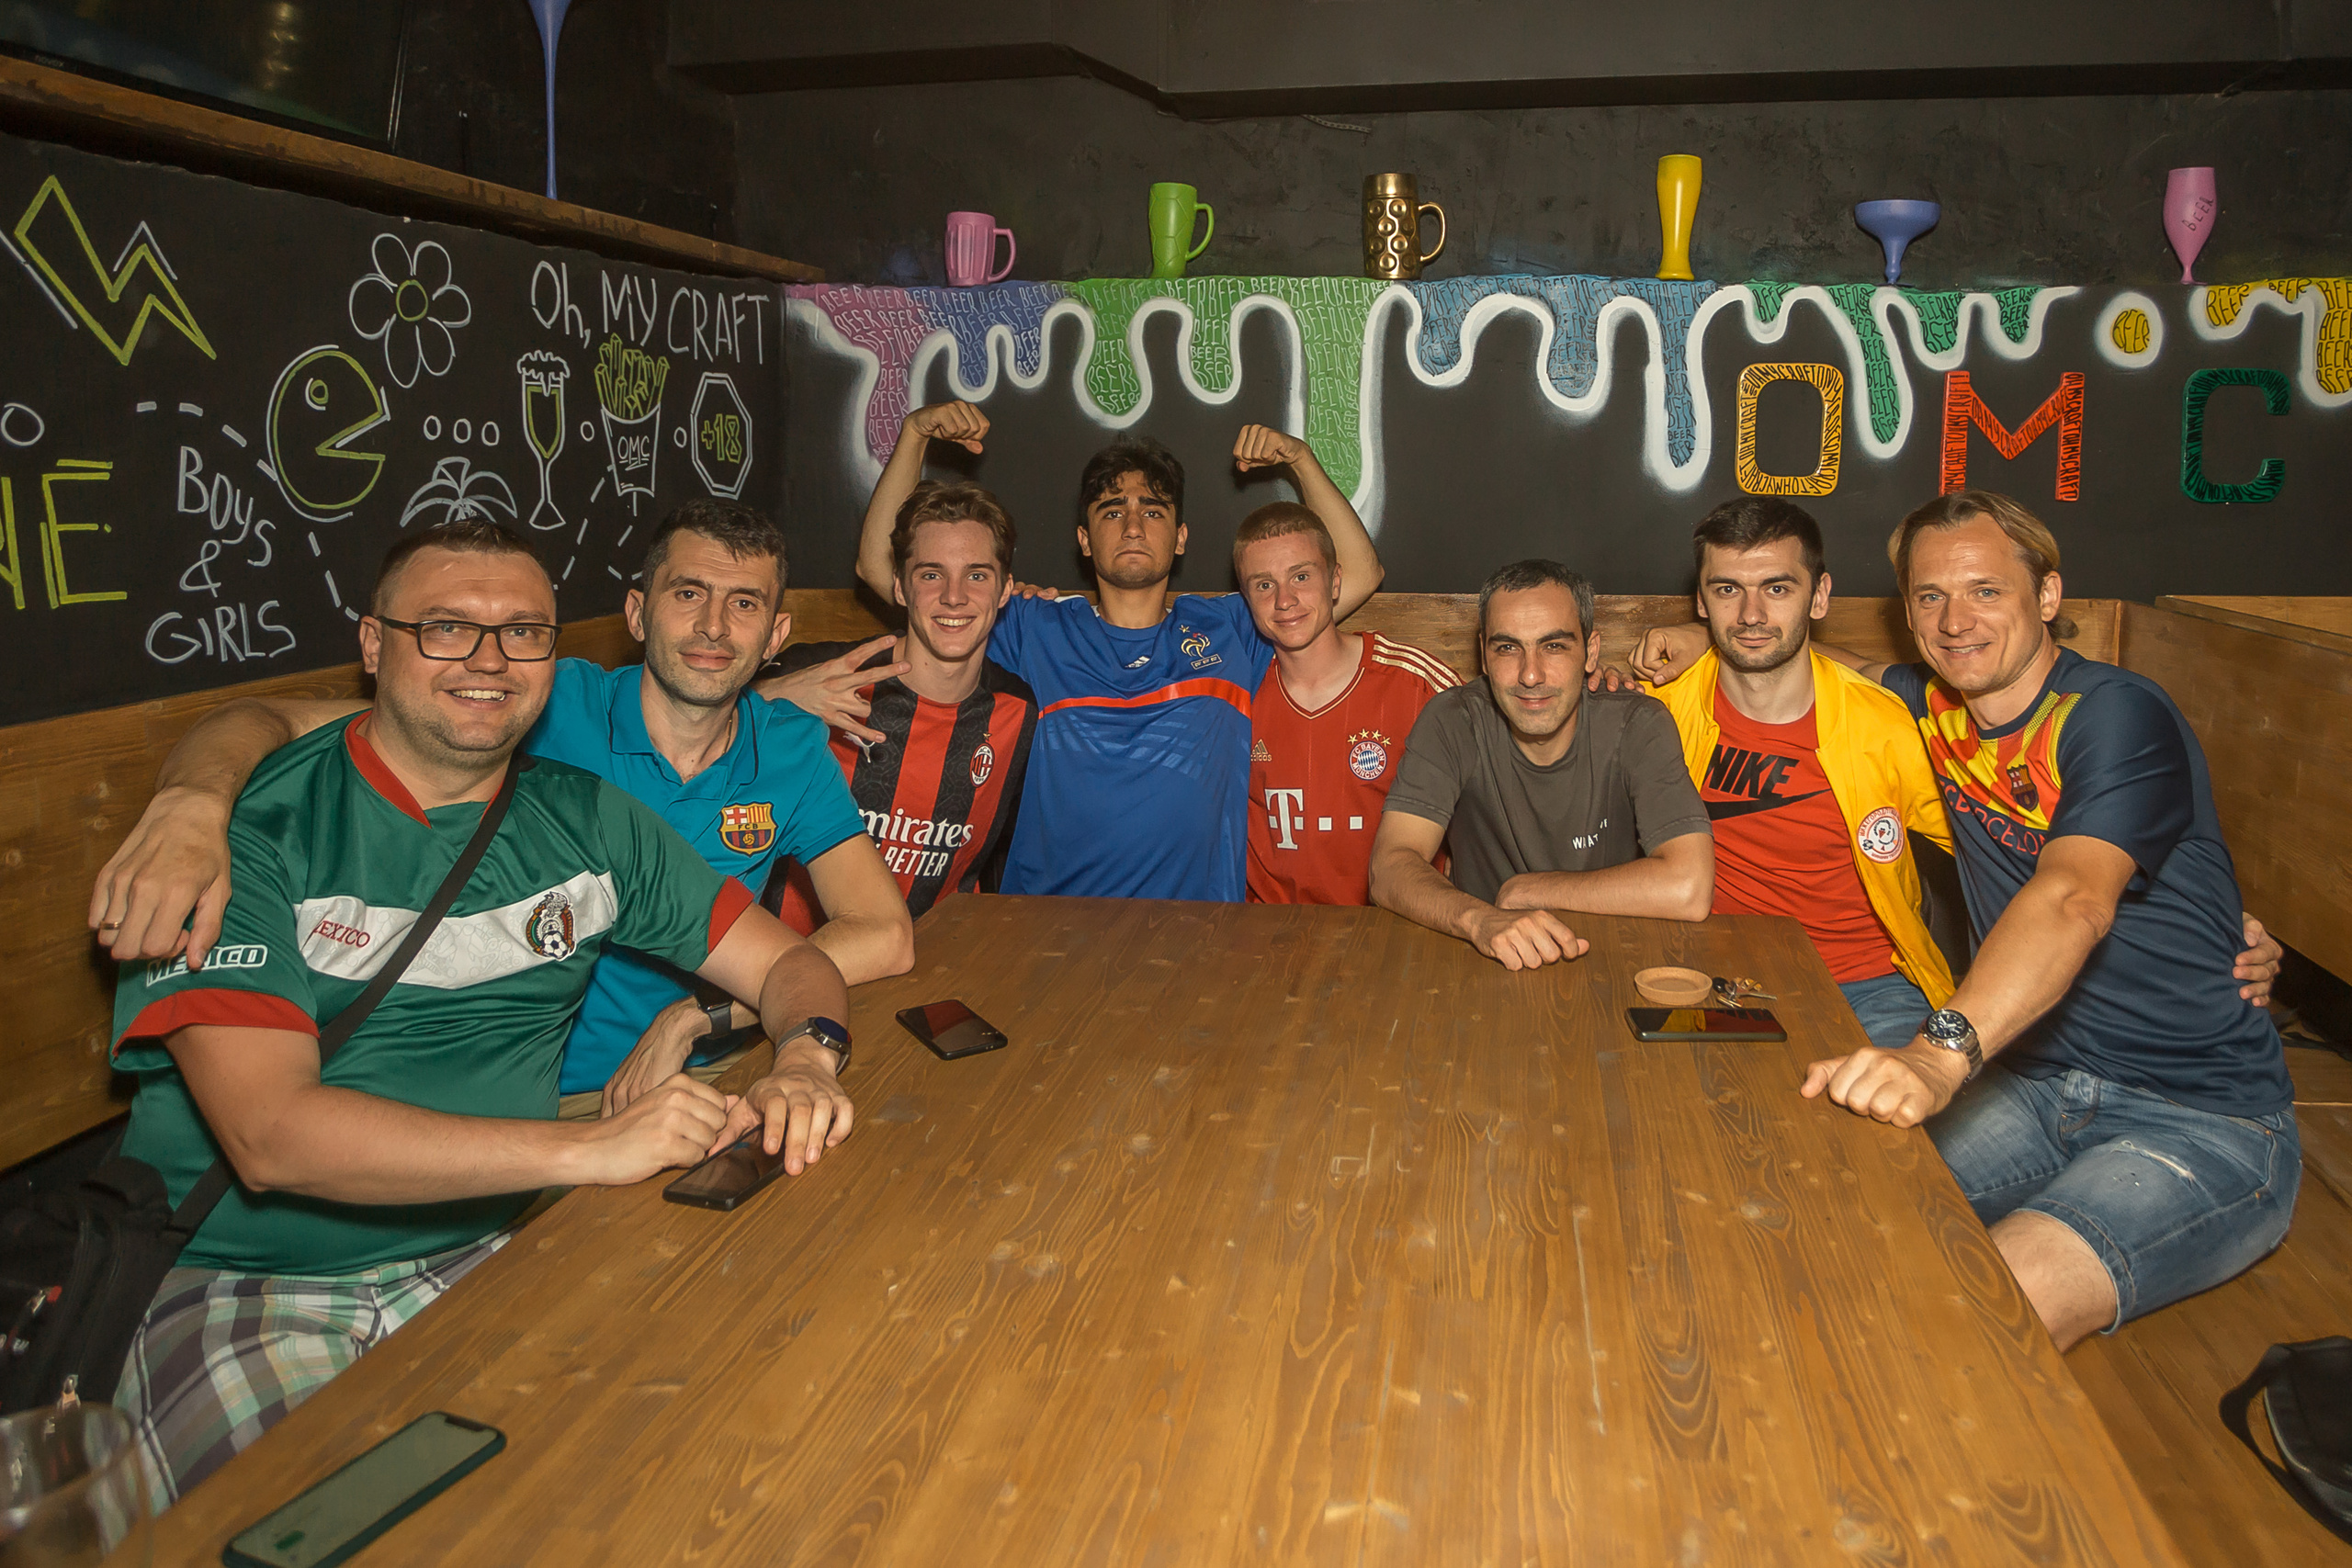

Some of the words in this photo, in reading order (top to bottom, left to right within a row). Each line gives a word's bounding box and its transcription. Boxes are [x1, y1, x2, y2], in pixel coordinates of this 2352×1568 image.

[820, 284, 865, 312] BEER
[903, 288, 942, 312] BEER
[943, 291, 980, 315] BEER
[978, 288, 1016, 313] BEER
[1019, 284, 1056, 308] BEER
[1166, 278, 1206, 332] BEER
[1209, 278, 1250, 318] BEER
[1250, 276, 1285, 301] BEER
[1286, 276, 1336, 309] BEER
[1331, 278, 1372, 306] BEER
[1624, 281, 1664, 321] BEER
[1662, 283, 1701, 321] BEER
[1752, 283, 1794, 322] BEER
[1828, 285, 1861, 315] BEER
[1996, 288, 2026, 310] BEER
[2206, 284, 2249, 326] BEER
[2268, 277, 2312, 304] BEER
[1906, 294, 1948, 321] BEER
[2000, 304, 2030, 325] BEER
[667, 287, 769, 364] CRAFT
[834, 309, 882, 337] BEER
[877, 309, 918, 328] BEER
[918, 308, 963, 340] BEER
[1193, 319, 1229, 350] BEER
[1295, 305, 1344, 343] BEER
[1420, 317, 1453, 346] BEER
[1660, 319, 1690, 351] BEER
[1850, 314, 1883, 338] BEER
[2112, 309, 2150, 354] BEER
[2320, 310, 2352, 341] BEE
[1014, 326, 1041, 359] BEER
[1092, 338, 1130, 366] BEER
[1190, 345, 1230, 364] BEER
[1663, 344, 1688, 372] BEER
[1860, 339, 1890, 363] BEER
[1305, 342, 1346, 378] BEER
[1866, 361, 1897, 389] BEER
[878, 367, 910, 391] BEER
[1192, 360, 1232, 392] BEER
[1666, 372, 1691, 396] BEER
[869, 390, 910, 418] BEER
[1310, 377, 1347, 409] BEER
[1868, 389, 1900, 418] BEER
[1308, 404, 1347, 438] BEER
[1667, 396, 1697, 429] BEER
[617, 436, 650, 460] OMC
[701, 413, 741, 463] +18
[1668, 429, 1696, 441] BEER
[1668, 440, 1694, 468] BEER
[180, 540, 221, 598] &
[145, 601, 297, 663] GIRLS
[1703, 744, 1800, 799] NIKE
[885, 846, 949, 877] BETTER
[313, 920, 370, 948] EXICO
[146, 944, 269, 988] MEICO
